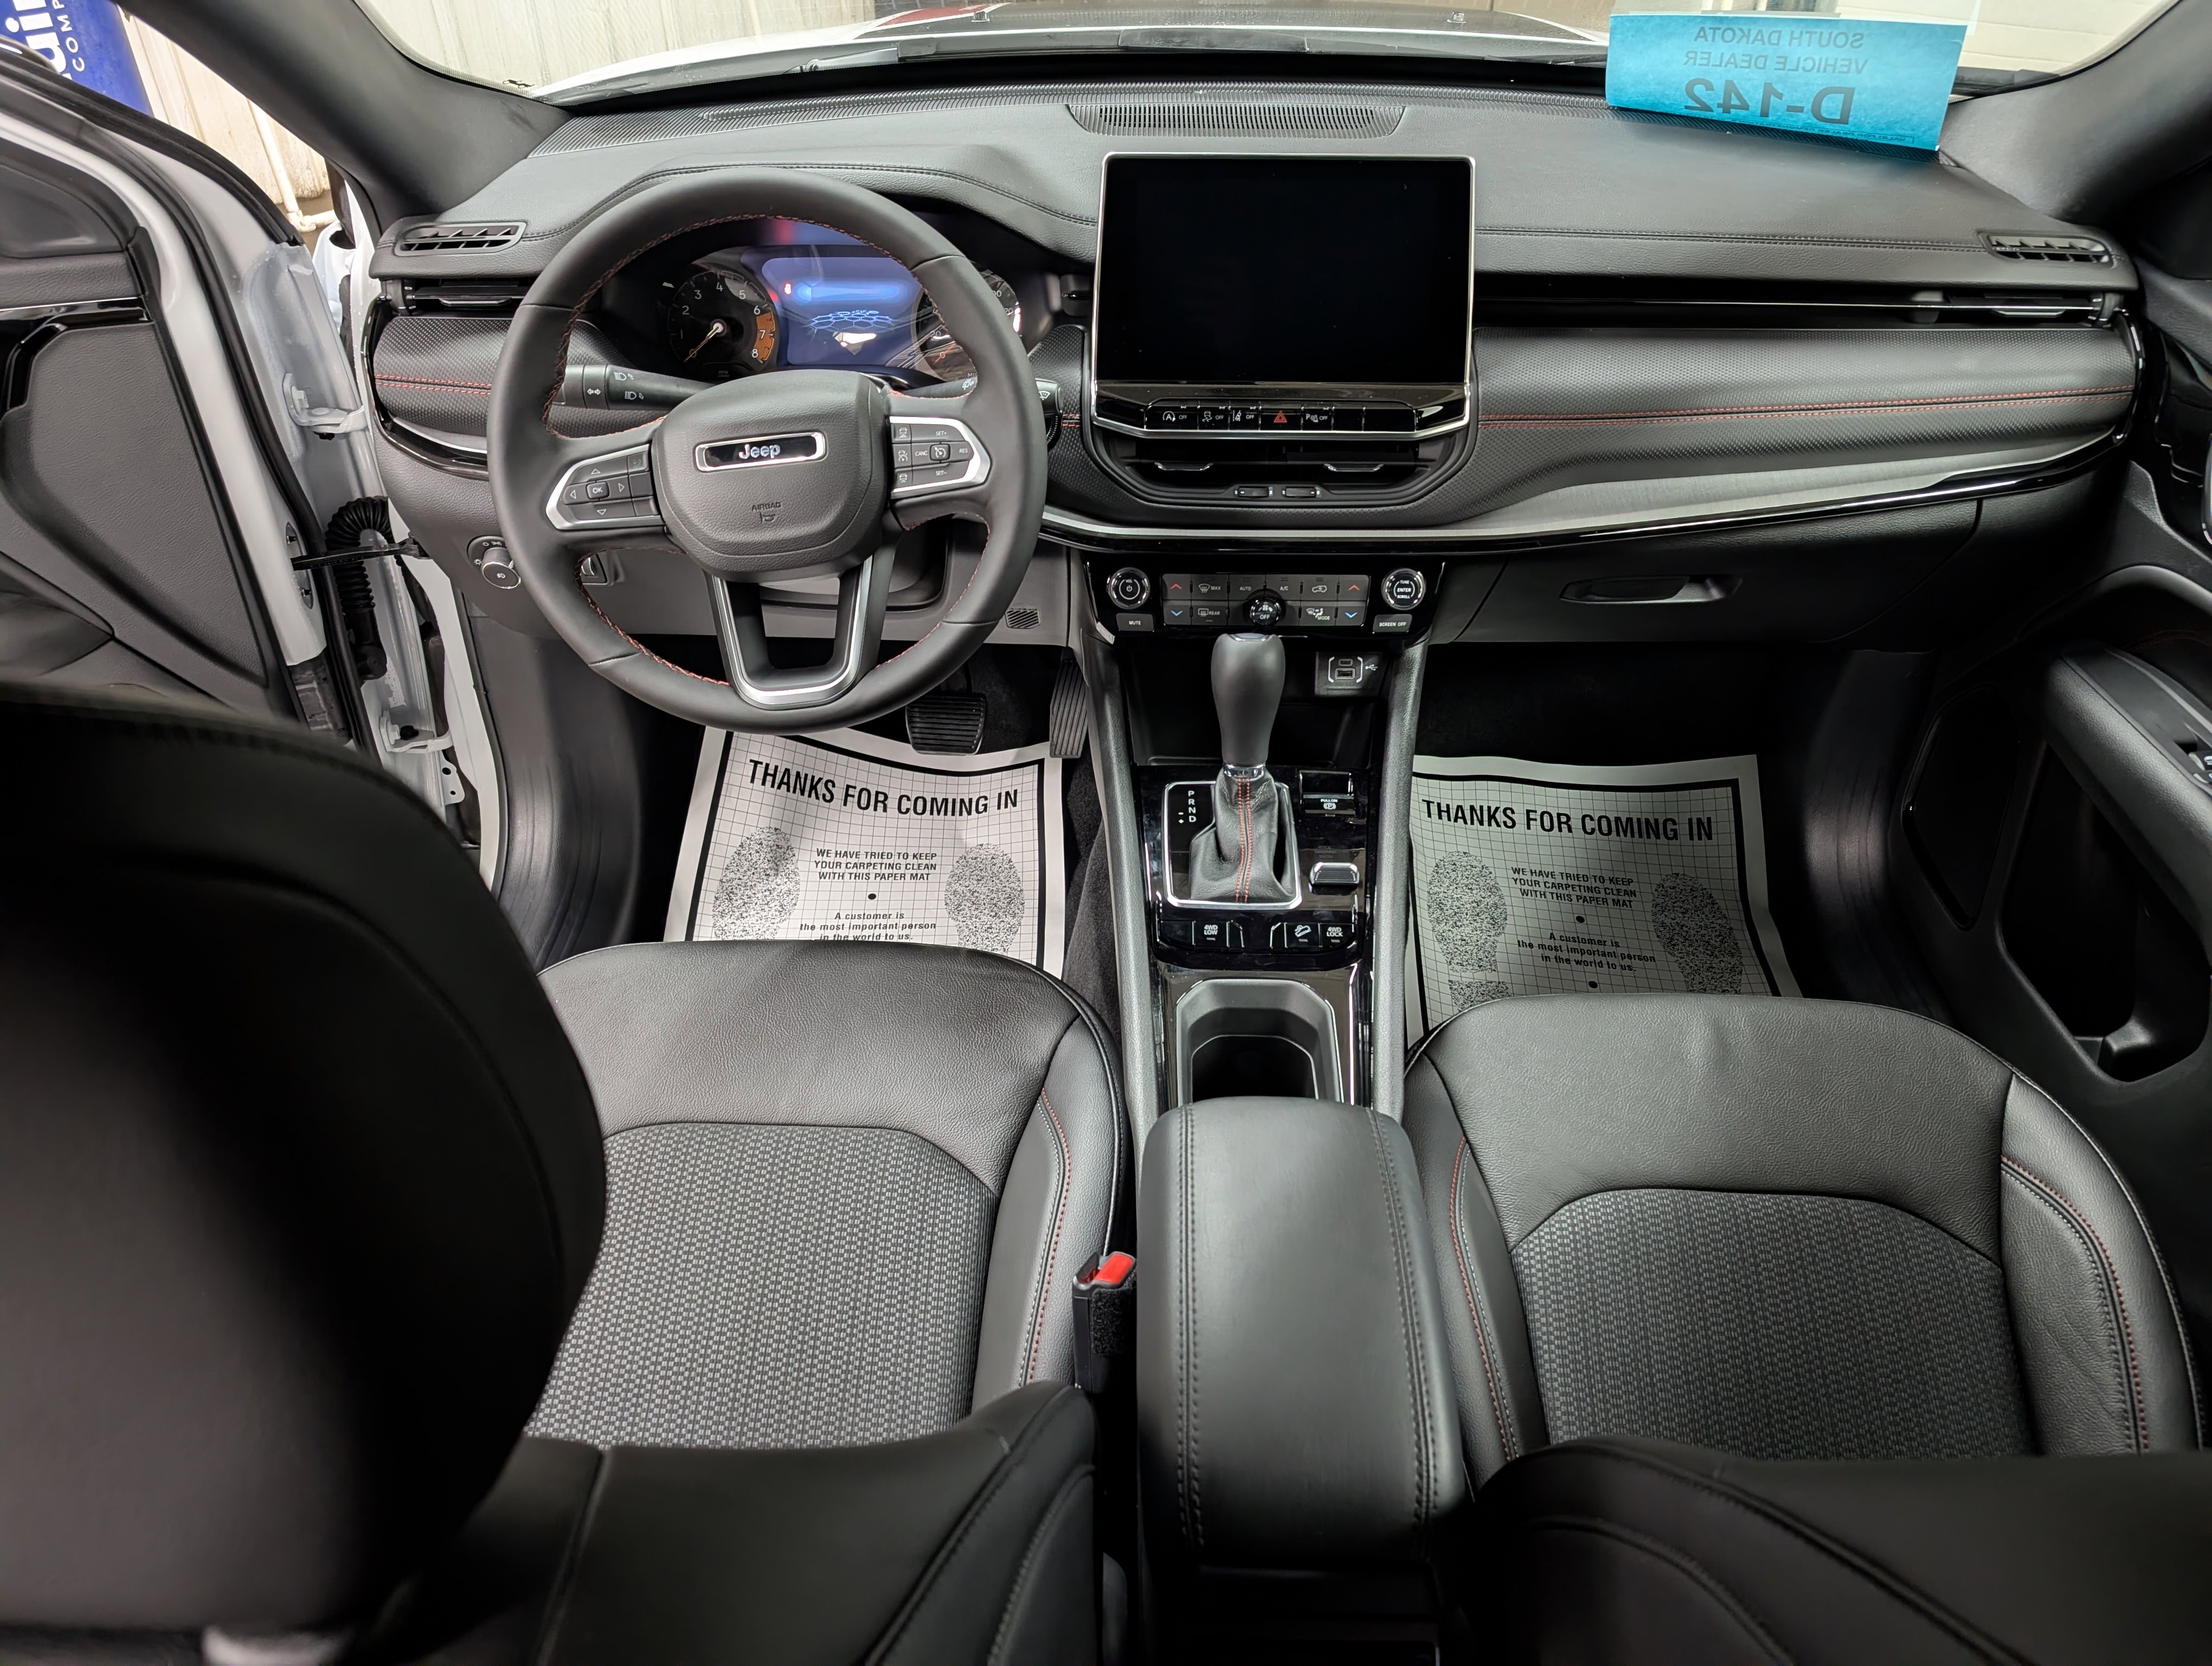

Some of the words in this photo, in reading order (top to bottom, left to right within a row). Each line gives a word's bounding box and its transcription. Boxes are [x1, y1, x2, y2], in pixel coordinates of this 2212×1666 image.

[716, 282, 724, 292] 4
[694, 290, 702, 300] 3
[738, 290, 746, 300] 5
[682, 305, 690, 315] 2
[753, 305, 761, 315] 6
[759, 330, 766, 339] 7
[751, 348, 758, 358] 8
[738, 444, 781, 459] Jeep
[751, 502, 781, 511] AIRBAG
[749, 759, 835, 803] THANKS
[843, 784, 889, 813] FOR
[897, 795, 989, 817] COMING
[996, 789, 1019, 811] IN
[1422, 799, 1516, 829] THANKS
[1526, 809, 1573, 834] FOR
[1580, 813, 1679, 841] COMING
[1688, 816, 1713, 841] IN
[816, 848, 832, 858] WE
[835, 850, 861, 859] HAVE
[864, 851, 893, 860] TRIED
[896, 852, 909, 860] TO
[912, 853, 937, 861] KEEP
[814, 860, 842, 869] YOUR
[845, 862, 902, 870] CARPETING
[905, 862, 937, 870] CLEAN
[818, 872, 844, 880] WITH
[847, 872, 871, 880] THIS
[873, 873, 906, 881] PAPER
[909, 873, 931, 881] MAT
[1511, 867, 1527, 875] WE
[1530, 869, 1556, 879] HAVE
[1559, 872, 1589, 882] TRIED
[1592, 875, 1605, 884] TO
[1609, 876, 1634, 886] KEEP
[1512, 877, 1541, 888] YOUR
[1544, 881, 1600, 894] CARPETING
[1604, 887, 1637, 898] CLEAN
[1519, 888, 1546, 899] WITH
[1548, 892, 1572, 902] THIS
[1576, 895, 1609, 906] PAPER
[1611, 898, 1633, 908] MAT
[896, 912, 905, 920] is
[848, 922, 898, 932] important
[901, 922, 936, 931] person
[820, 933, 829, 941] in
[833, 933, 849, 941] the
[853, 933, 881, 941] world
[1549, 932, 1556, 940] A
[1559, 934, 1607, 946] customer
[1610, 939, 1620, 948] is
[1517, 940, 1534, 949] the
[1537, 943, 1563, 953] most
[1566, 945, 1617, 959] important
[1620, 952, 1656, 963] person
[1541, 953, 1551, 963] in
[1554, 956, 1571, 965] the
[1574, 958, 1603, 968] world
[1606, 961, 1617, 970] to
[1619, 964, 1637, 972] us.
